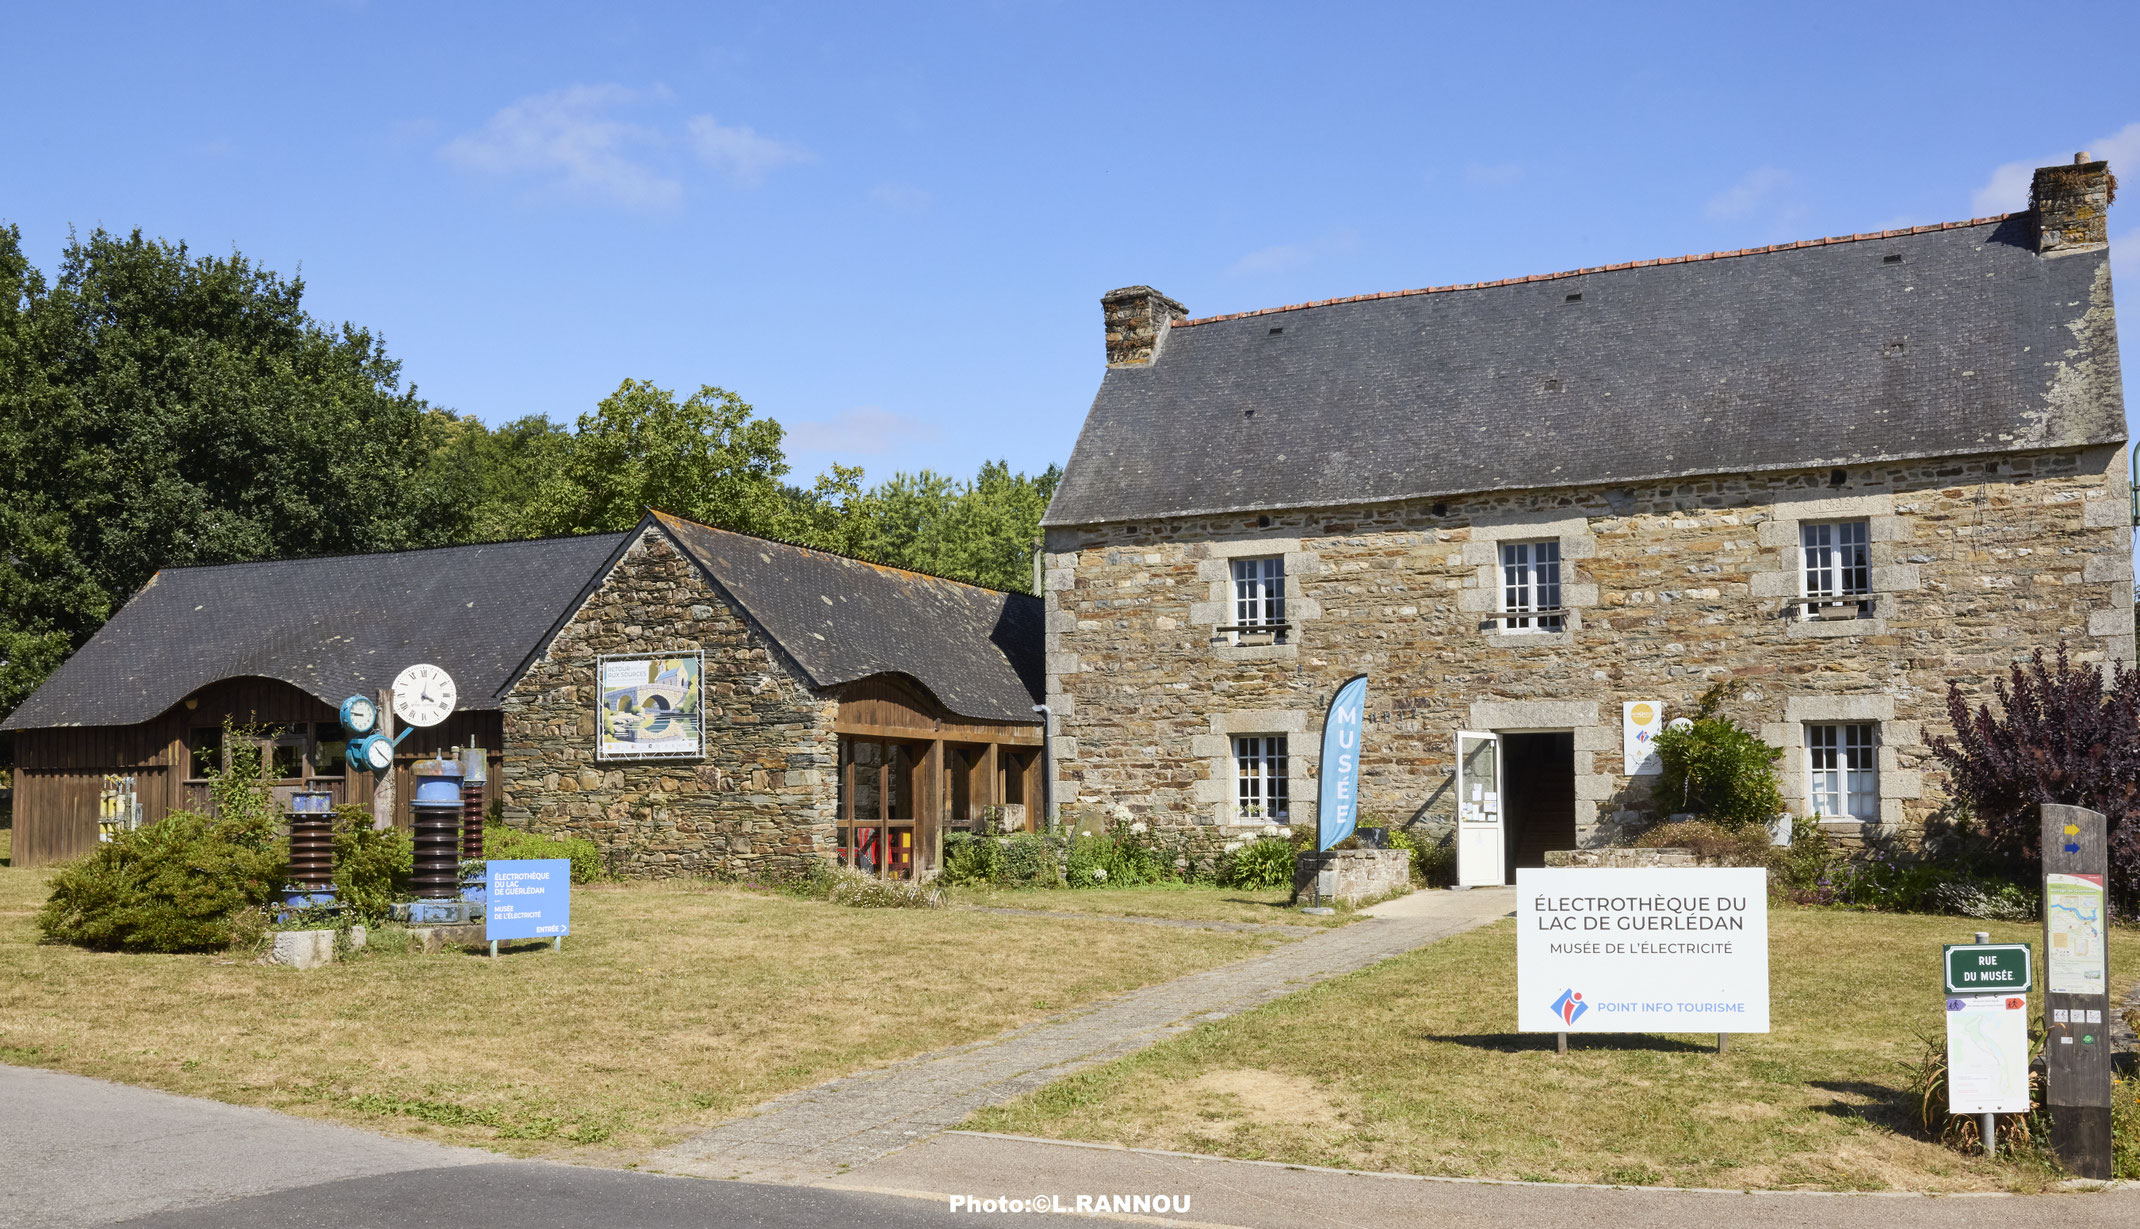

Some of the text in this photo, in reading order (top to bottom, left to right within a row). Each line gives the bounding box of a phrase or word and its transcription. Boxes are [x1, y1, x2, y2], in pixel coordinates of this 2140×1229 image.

[1337, 706, 1356, 824] MUSÉE
[494, 872, 549, 881] ÉLECTROTHÈQUE
[505, 886, 544, 895] GUERLÉDAN
[1535, 893, 1747, 914] ÉLECTROTHÈQUE DU
[1538, 913, 1744, 931] LAC DE GUERLÉDAN
[536, 925, 559, 933] ENTRÉE
[1550, 941, 1733, 954] MUSÉE DE L'ÉLECTRICITÉ
[1978, 955, 1998, 966] RUE
[1964, 971, 1977, 982] DU
[1597, 1002, 1745, 1013] POINT INFO TOURISME
